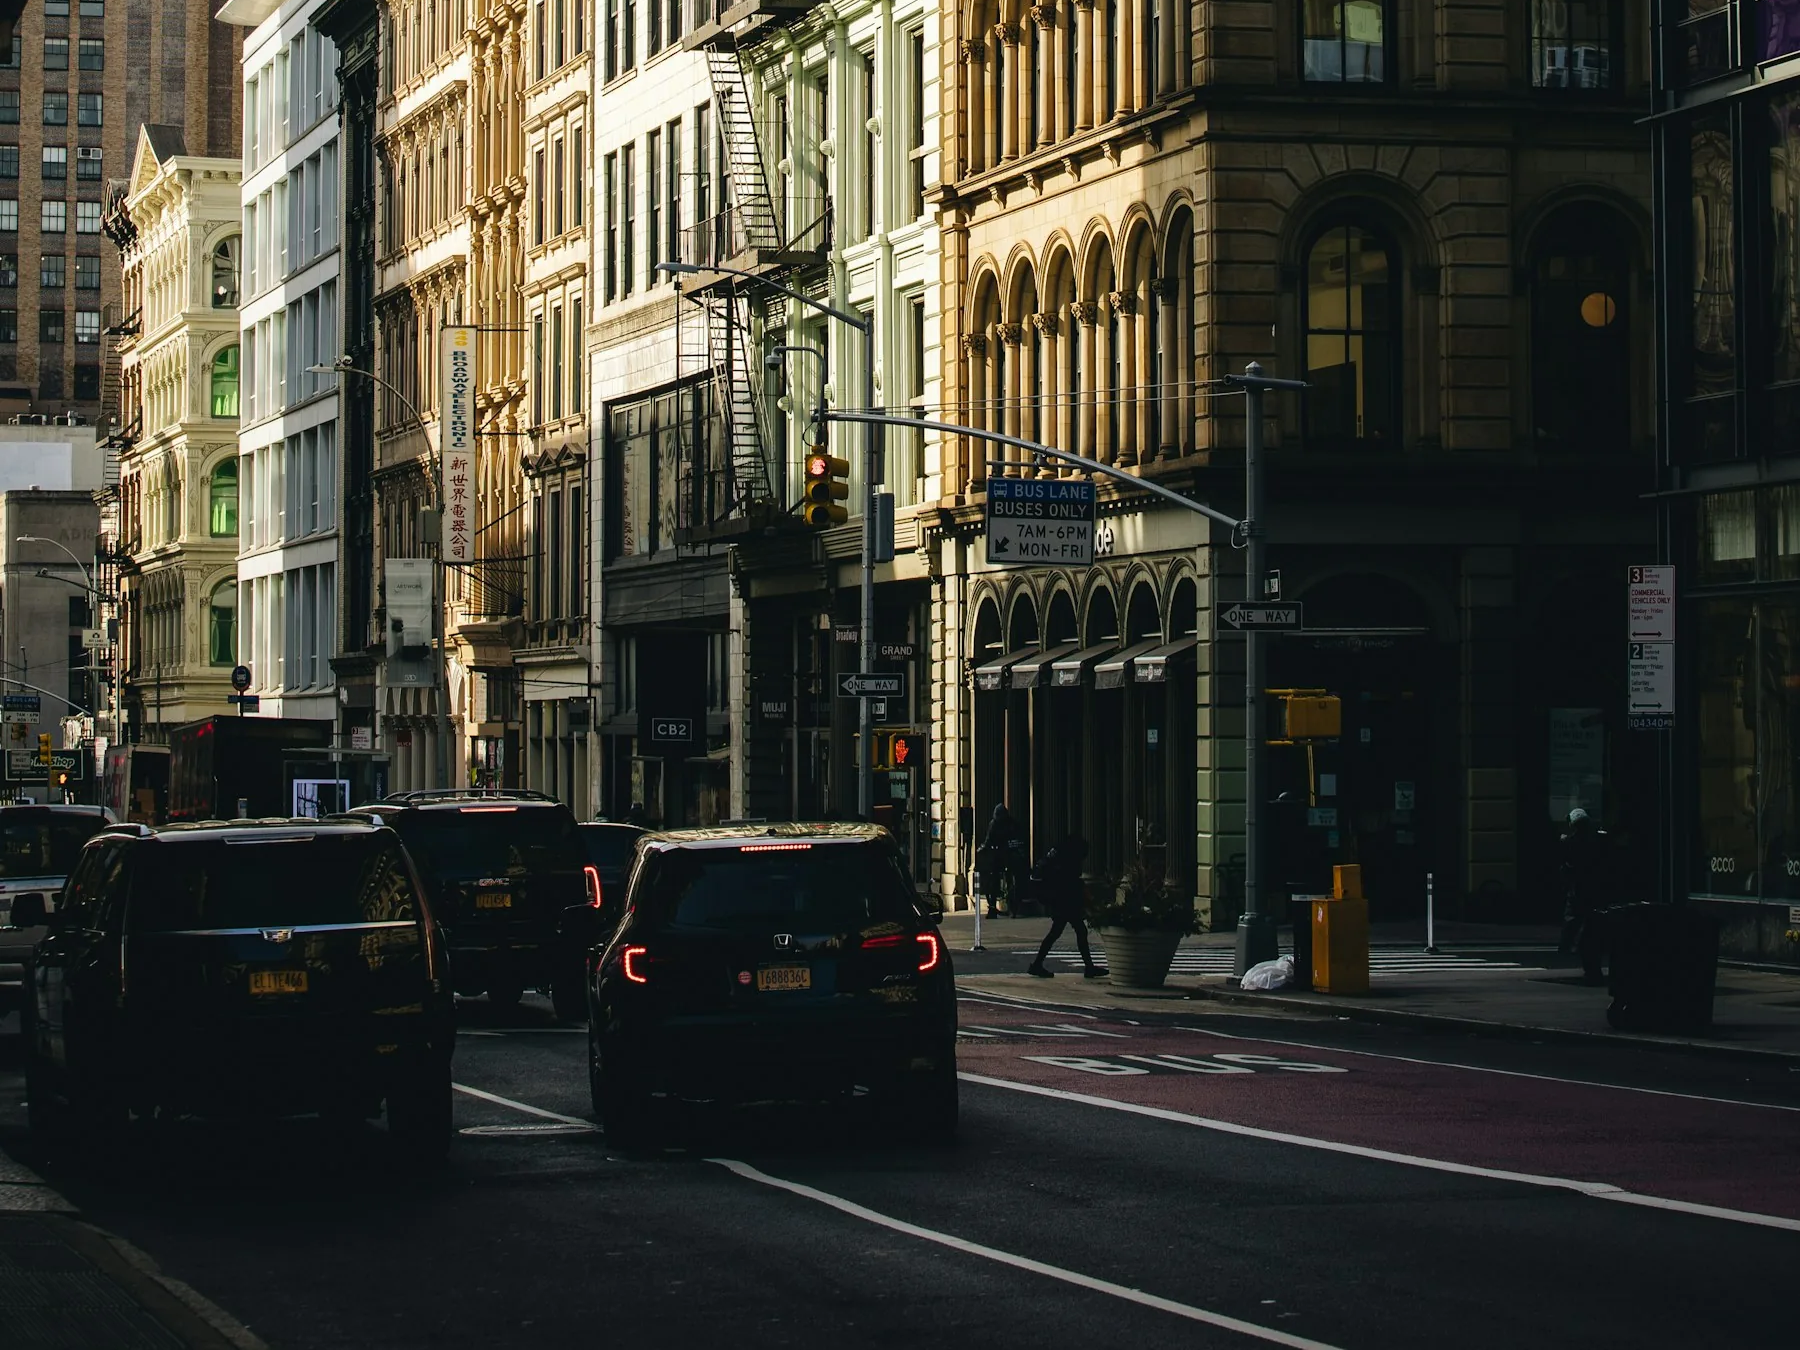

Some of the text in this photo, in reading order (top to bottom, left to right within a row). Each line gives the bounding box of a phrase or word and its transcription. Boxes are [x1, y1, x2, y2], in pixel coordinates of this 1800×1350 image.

[1014, 483, 1089, 500] BUS LANE
[449, 456, 470, 559] 新世界電器公司
[994, 501, 1088, 518] BUSES ONLY
[1019, 542, 1084, 558] MON-FRI
[1632, 567, 1640, 583] 3
[1229, 611, 1291, 622] ONE WAY
[835, 629, 858, 643] Broadway
[881, 645, 913, 656] GRAND
[1632, 644, 1640, 658] 2
[847, 680, 894, 690] ONE WAY
[762, 701, 787, 712] MUJI
[657, 723, 687, 736] CB2
[1630, 718, 1664, 728] 104340
[1710, 856, 1735, 873] ecco
[478, 877, 510, 887] GMC
[1019, 1053, 1350, 1077] BUS
